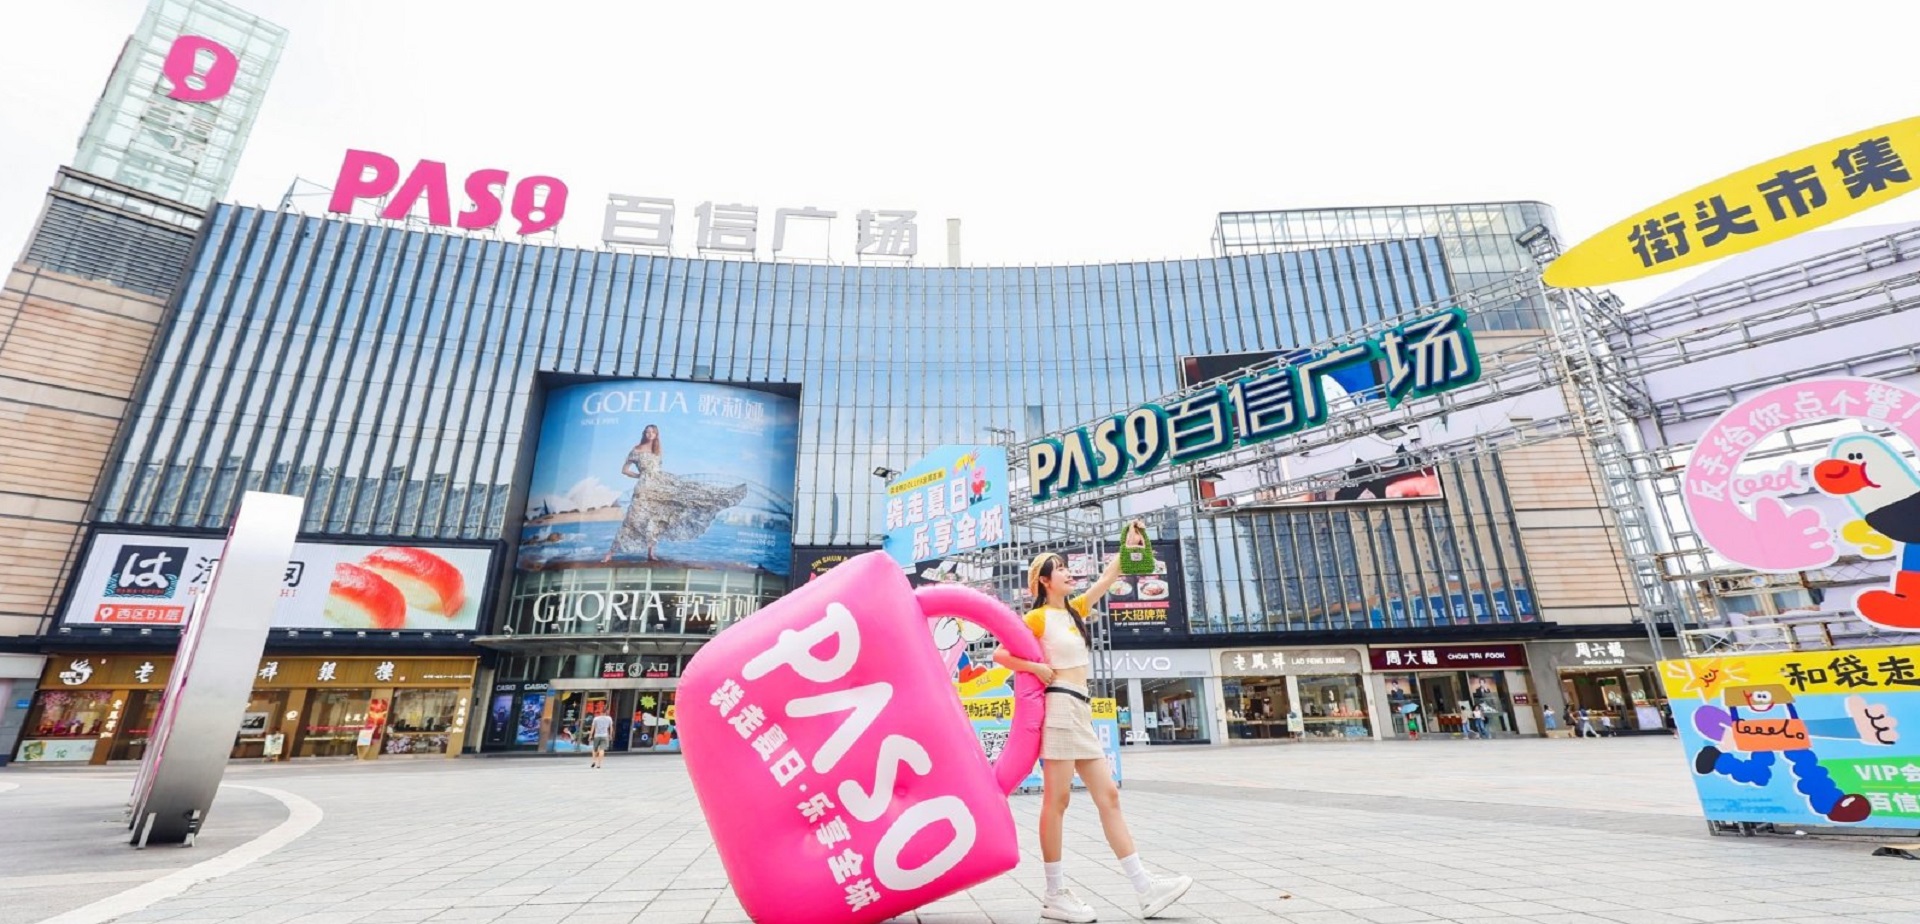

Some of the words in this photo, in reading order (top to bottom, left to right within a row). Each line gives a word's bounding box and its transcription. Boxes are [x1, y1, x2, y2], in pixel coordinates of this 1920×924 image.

[328, 148, 568, 235] PASO
[602, 193, 917, 255] 百信广场
[1627, 136, 1912, 268] 街头市集
[1167, 313, 1470, 460] 百信广场
[582, 390, 688, 415] GOELIA
[913, 504, 1003, 560] 乐享全城
[119, 551, 172, 589] は
[116, 607, 180, 621] 西区B1层
[533, 591, 667, 622] GLORIA
[1110, 609, 1168, 622] 十大招牌菜
[1104, 653, 1171, 671] vivo
[1386, 650, 1438, 665] 周大福
[1575, 642, 1625, 659] 周六福
[604, 662, 626, 672] 东区
[646, 662, 669, 672] 入口
[1783, 654, 1920, 692] 和袋走
[1865, 791, 1920, 813] 百信
